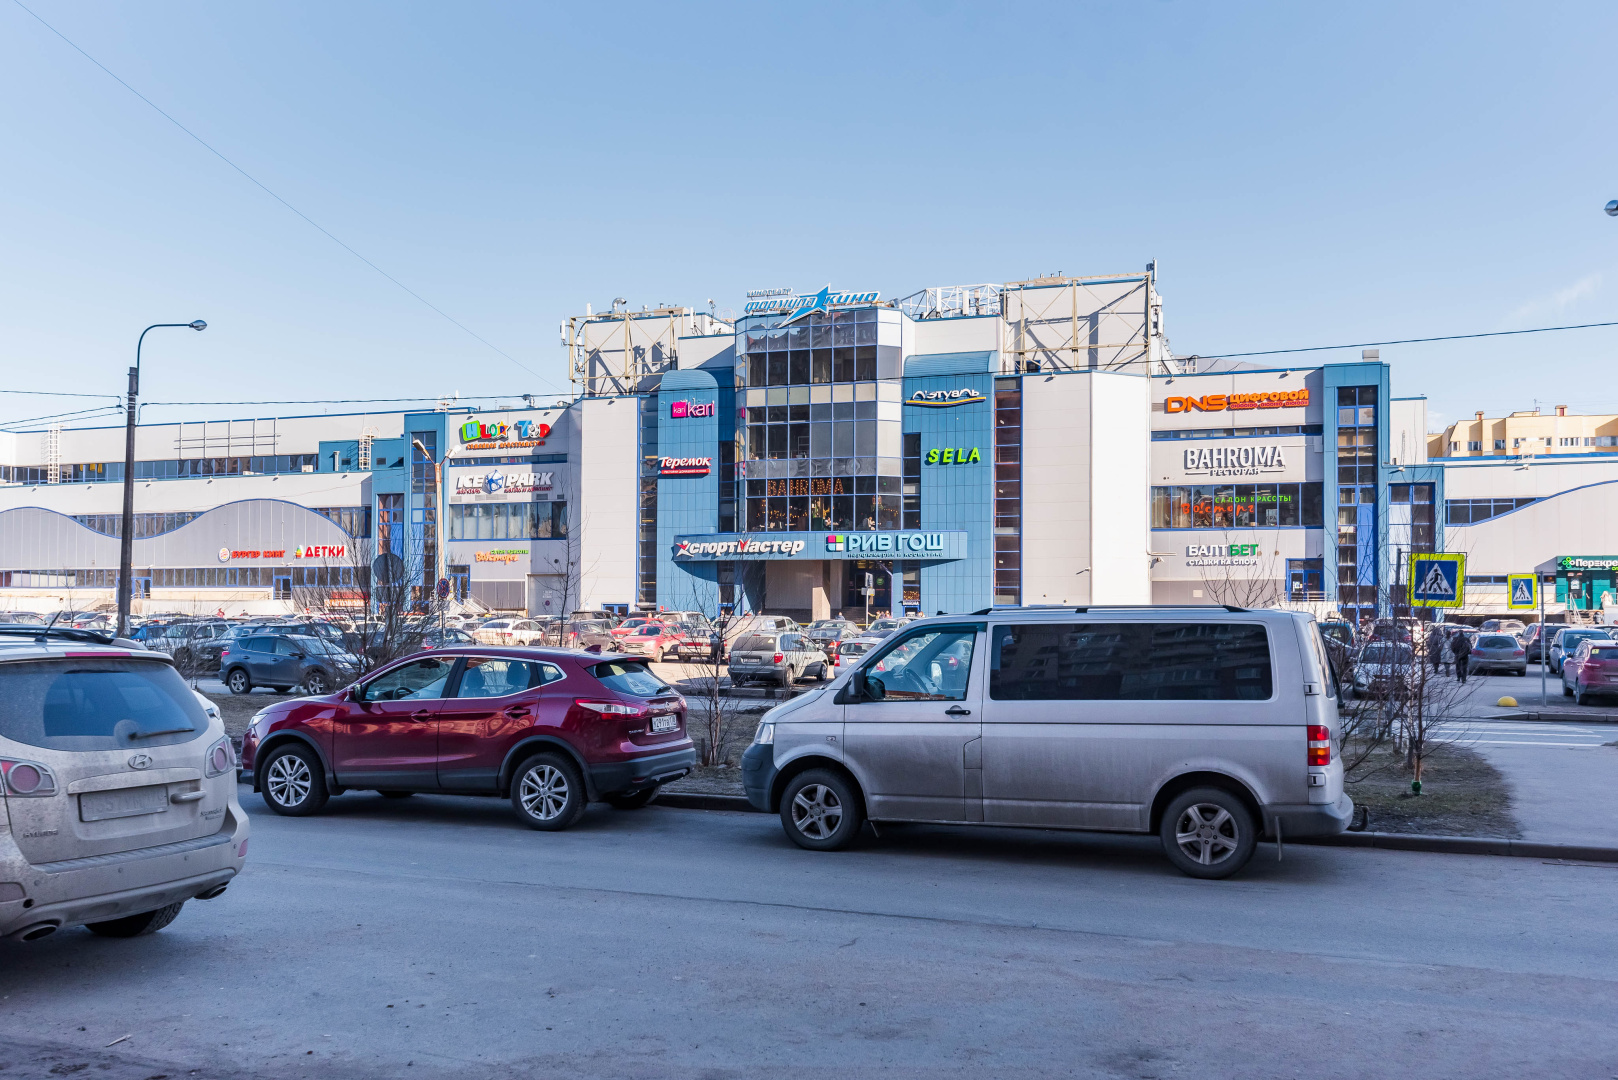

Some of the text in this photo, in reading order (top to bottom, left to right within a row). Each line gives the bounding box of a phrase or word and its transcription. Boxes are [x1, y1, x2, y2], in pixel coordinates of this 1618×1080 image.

[1229, 387, 1309, 403] ЦИФРОВОЙ
[688, 400, 715, 416] kari
[1167, 394, 1228, 413] DNS
[659, 456, 713, 469] Теремок
[928, 447, 981, 463] SELA
[1187, 445, 1287, 468] BAHROMA
[458, 471, 554, 488] ICE PARK
[1210, 468, 1259, 476] РЕСТОРАН
[767, 478, 844, 497] BAHROMA
[1214, 495, 1291, 504] САЛОН КРАСОТЫ
[848, 533, 944, 551] РИВ ГОШ
[1188, 543, 1259, 556] БАЛТБЕТ
[231, 550, 260, 559] БУРГЕР
[263, 549, 286, 559] КИНГ
[304, 545, 345, 558] ДЕТКИ
[1233, 558, 1259, 566] СПОРТ
